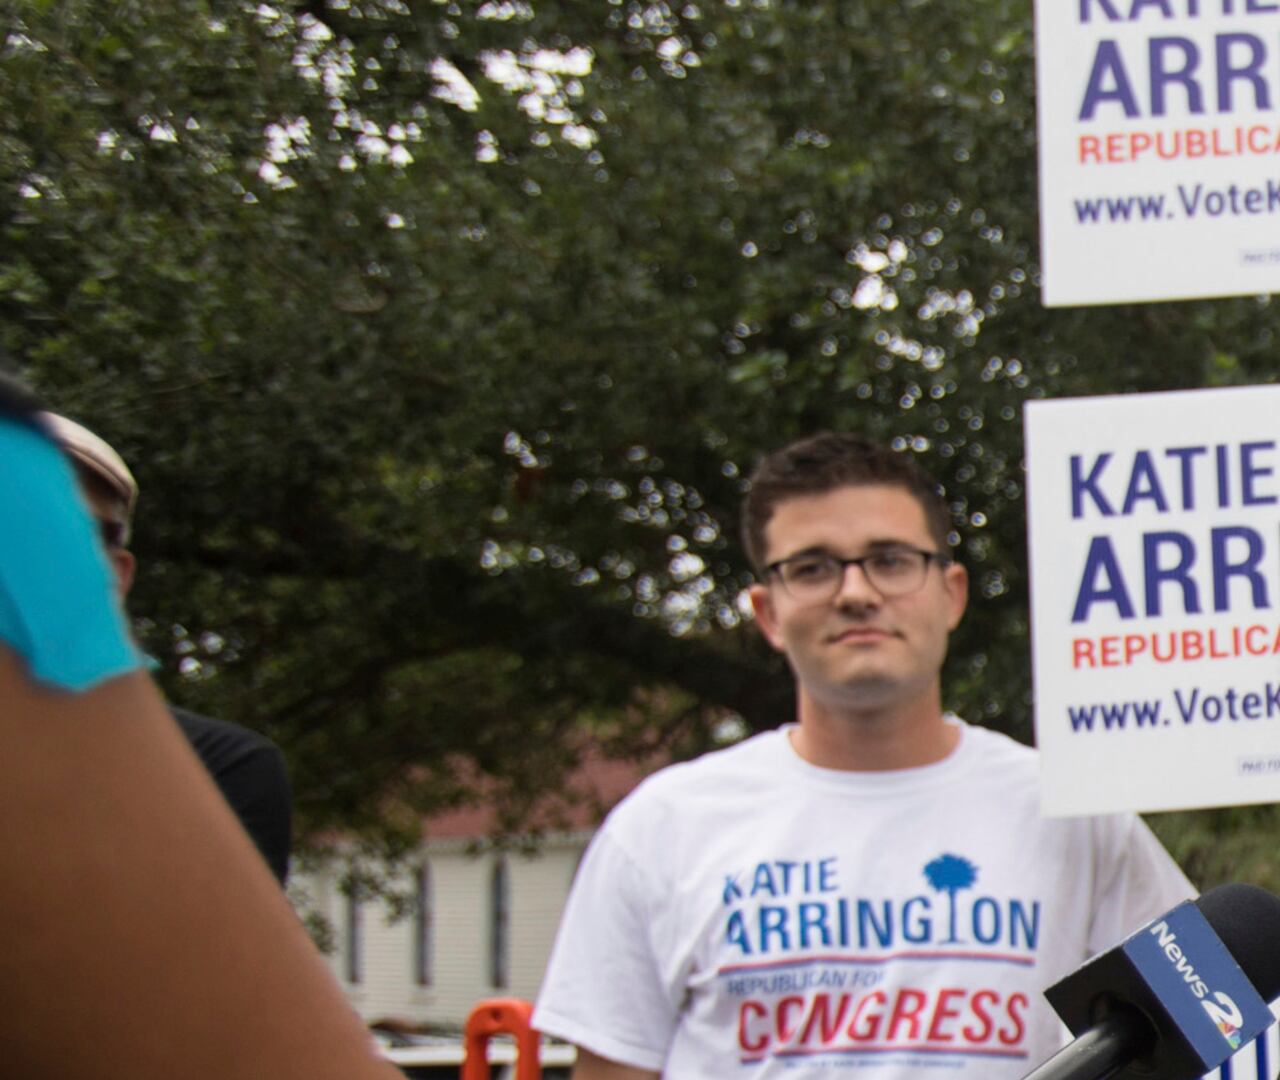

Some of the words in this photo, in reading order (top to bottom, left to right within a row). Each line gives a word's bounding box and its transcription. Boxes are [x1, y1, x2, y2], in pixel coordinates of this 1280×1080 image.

[1069, 441, 1279, 519] KATIE
[722, 857, 839, 906] KATIE
[723, 888, 1041, 956] ARRINGTON
[727, 969, 848, 998] REPUBLICAN
[1150, 920, 1210, 999] News
[1201, 991, 1244, 1049] 2
[738, 986, 1030, 1054] CONGRESS
